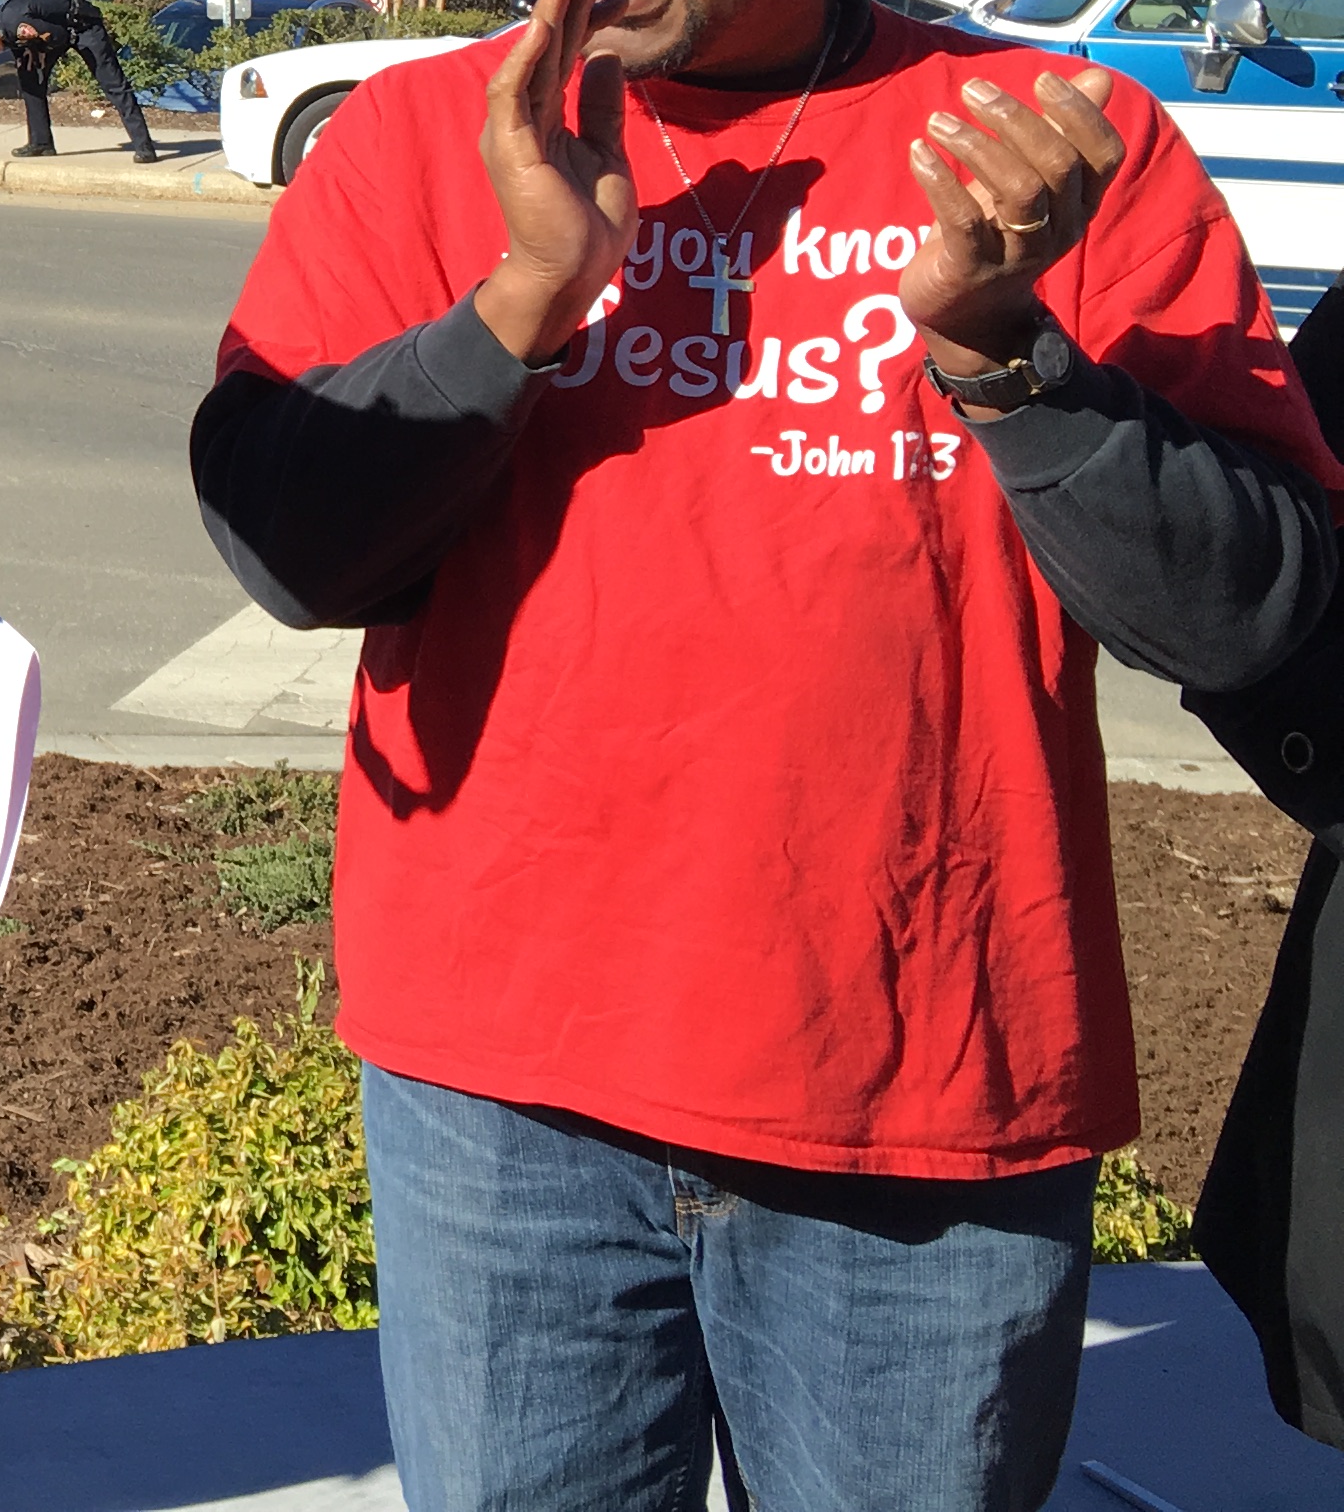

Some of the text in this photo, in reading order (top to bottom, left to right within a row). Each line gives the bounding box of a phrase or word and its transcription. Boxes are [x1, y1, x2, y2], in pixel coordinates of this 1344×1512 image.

[624, 206, 931, 290] you kno
[551, 283, 917, 414] Jesus?
[750, 429, 961, 481] -John 17:3
